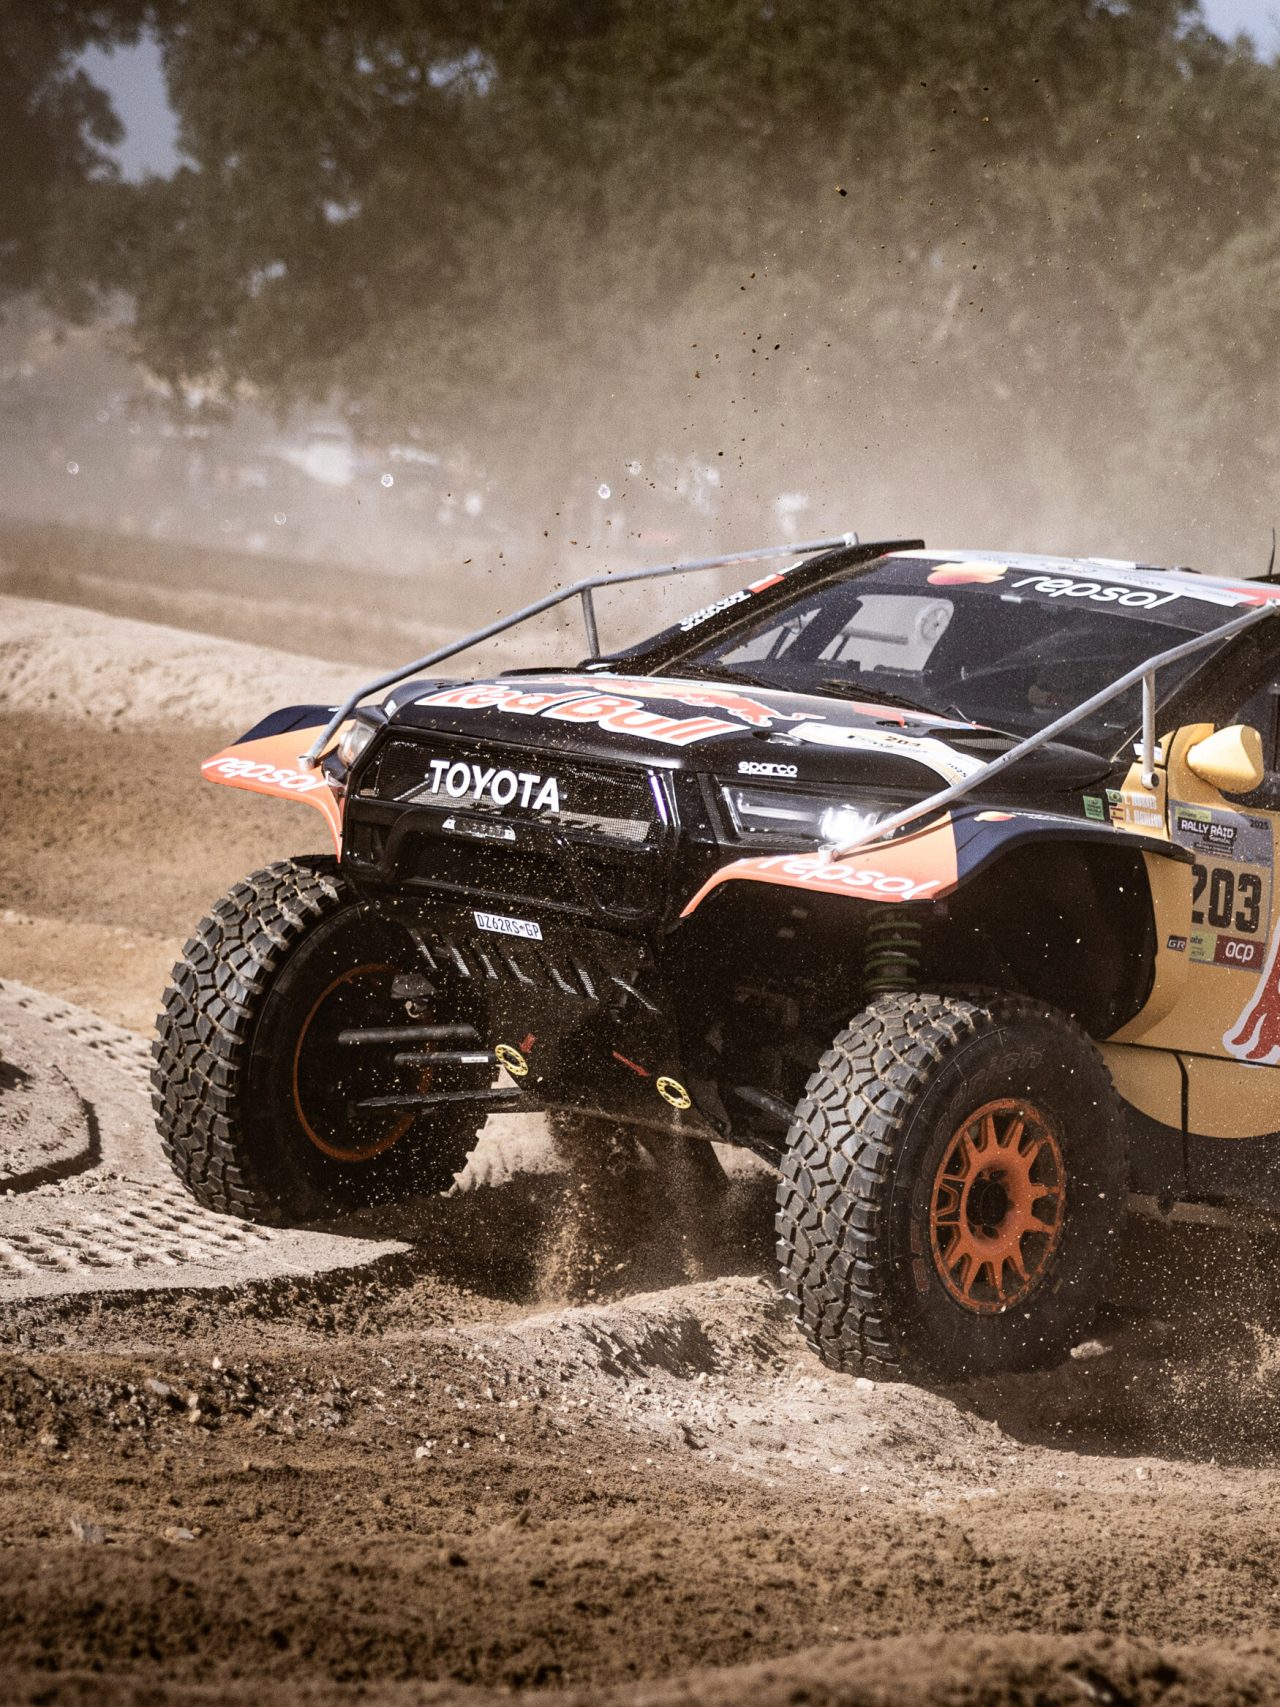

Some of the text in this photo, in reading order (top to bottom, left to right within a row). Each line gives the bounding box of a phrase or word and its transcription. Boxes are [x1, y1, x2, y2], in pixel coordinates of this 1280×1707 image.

[1011, 576, 1183, 610] repsol
[201, 757, 330, 792] repsol
[429, 760, 560, 812] TOYOTA
[738, 761, 797, 777] sparco
[1181, 820, 1208, 834] RALLY
[1210, 825, 1234, 839] RAID
[757, 855, 940, 900] repsol
[1191, 864, 1261, 933] 203
[1168, 937, 1186, 950] GR
